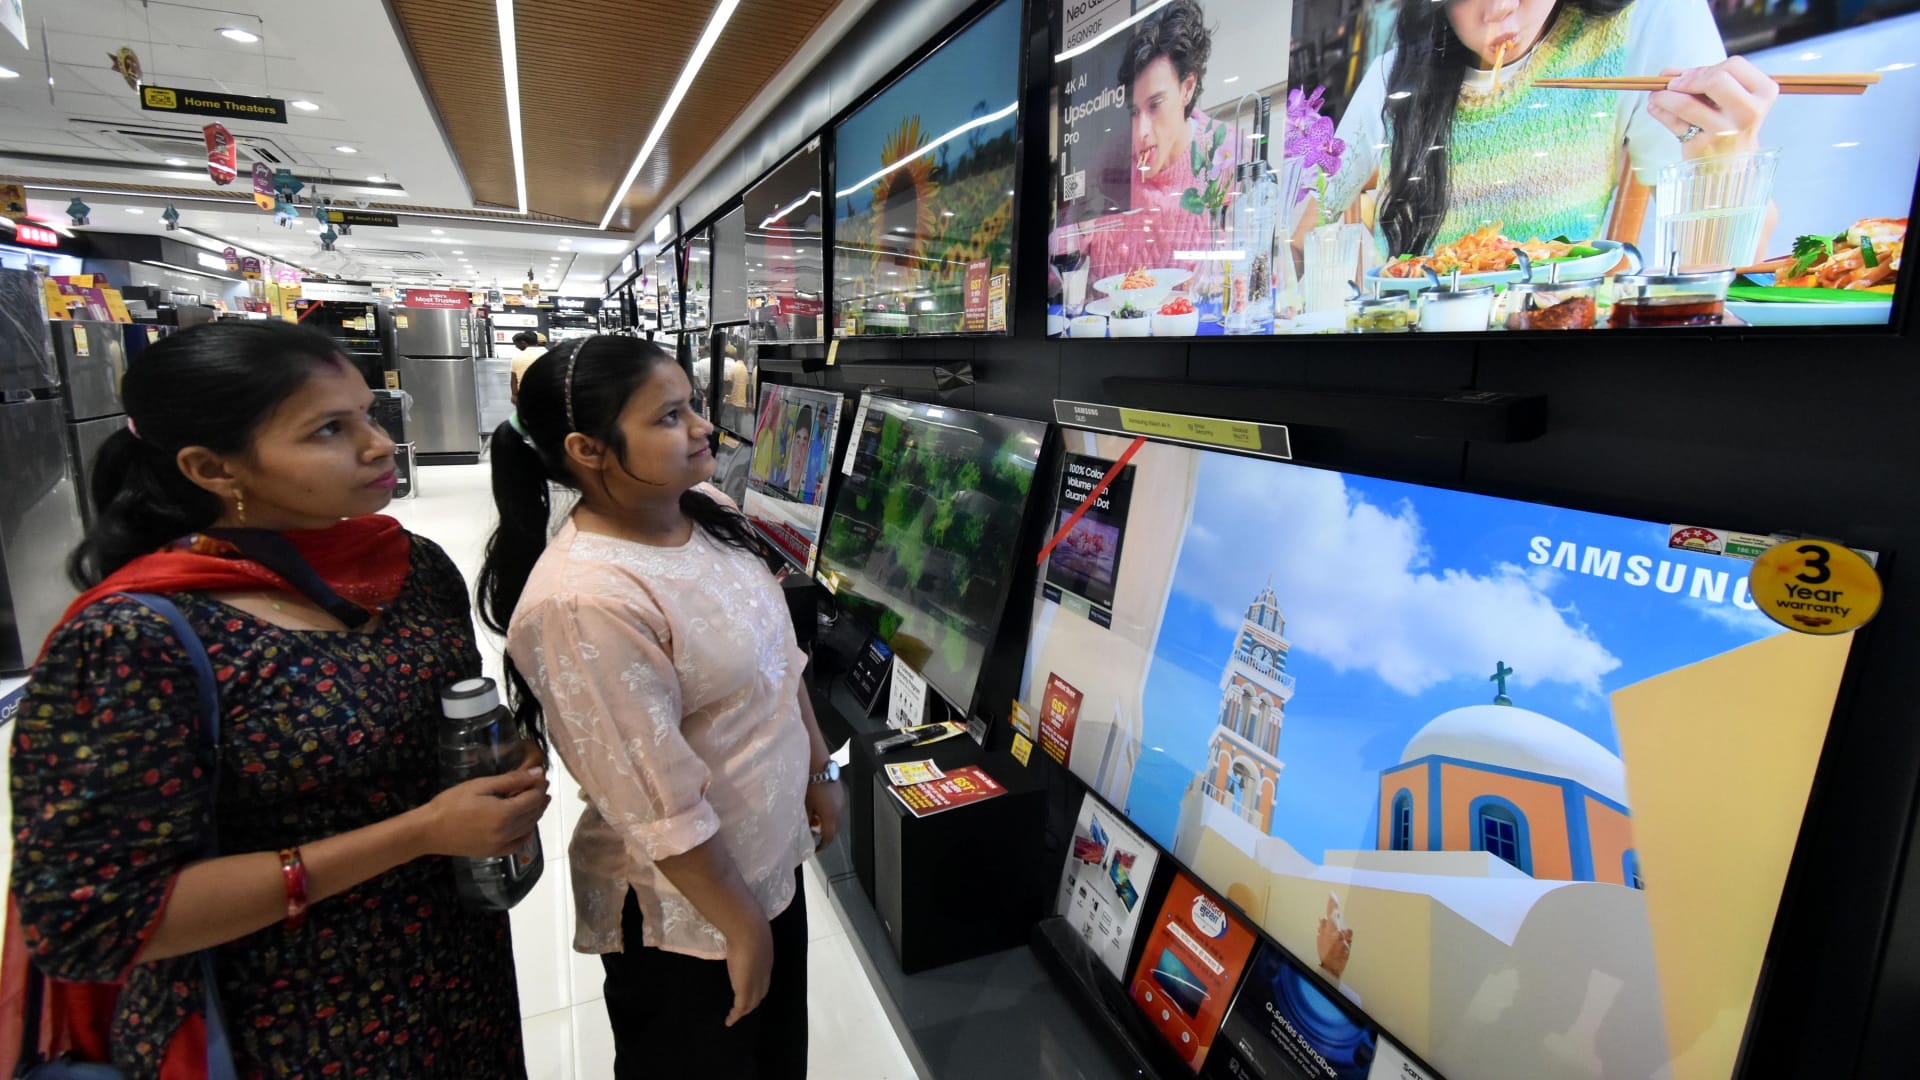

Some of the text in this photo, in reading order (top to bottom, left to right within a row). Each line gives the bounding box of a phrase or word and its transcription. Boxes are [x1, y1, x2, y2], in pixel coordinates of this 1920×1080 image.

[1067, 2, 1086, 23] Neo
[1064, 72, 1088, 95] 4K AI
[184, 96, 276, 115] Home Theaters
[1064, 84, 1125, 128] Upscaling
[1074, 406, 1099, 416] SAMSUNG
[1069, 463, 1104, 480] 100% Color
[1067, 476, 1091, 490] Volume
[1096, 498, 1110, 510] Dot
[1795, 544, 1831, 585] 3
[1784, 582, 1844, 603] Year
[1776, 599, 1850, 619] warranty
[1052, 698, 1068, 716] GST
[953, 777, 976, 791] GST
[1265, 1001, 1338, 1079] Q-Series Soundbar
